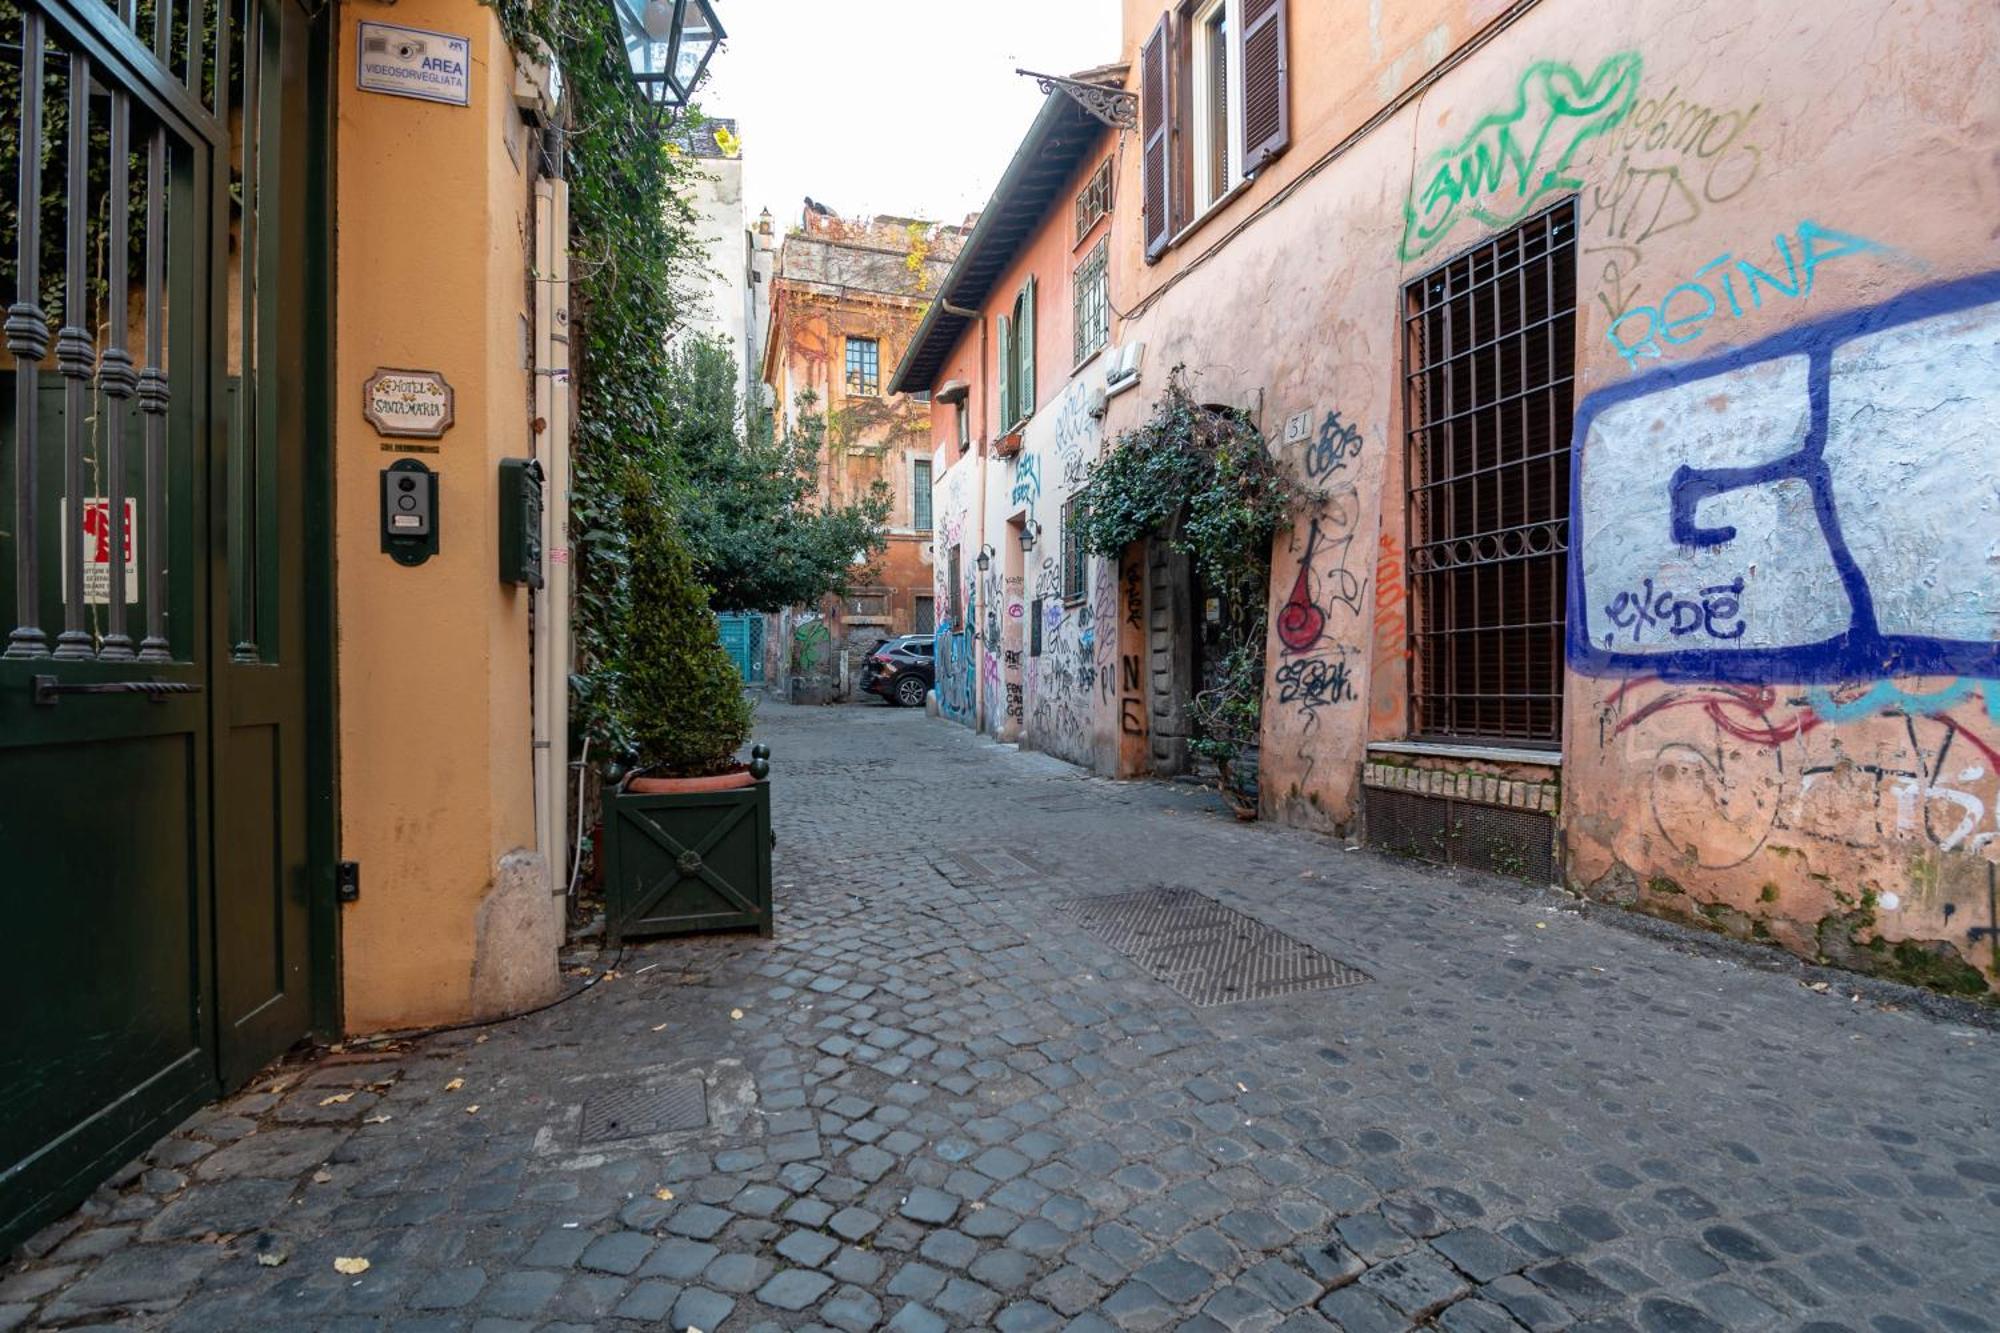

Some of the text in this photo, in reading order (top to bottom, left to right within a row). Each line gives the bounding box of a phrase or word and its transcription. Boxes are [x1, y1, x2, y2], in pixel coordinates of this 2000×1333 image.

[365, 63, 463, 87] VIDEOSORVEGLIATA
[421, 56, 464, 76] AREA
[392, 379, 426, 394] HOTEL
[375, 399, 441, 417] SANTA MARIA
[1289, 414, 1307, 438] 31
